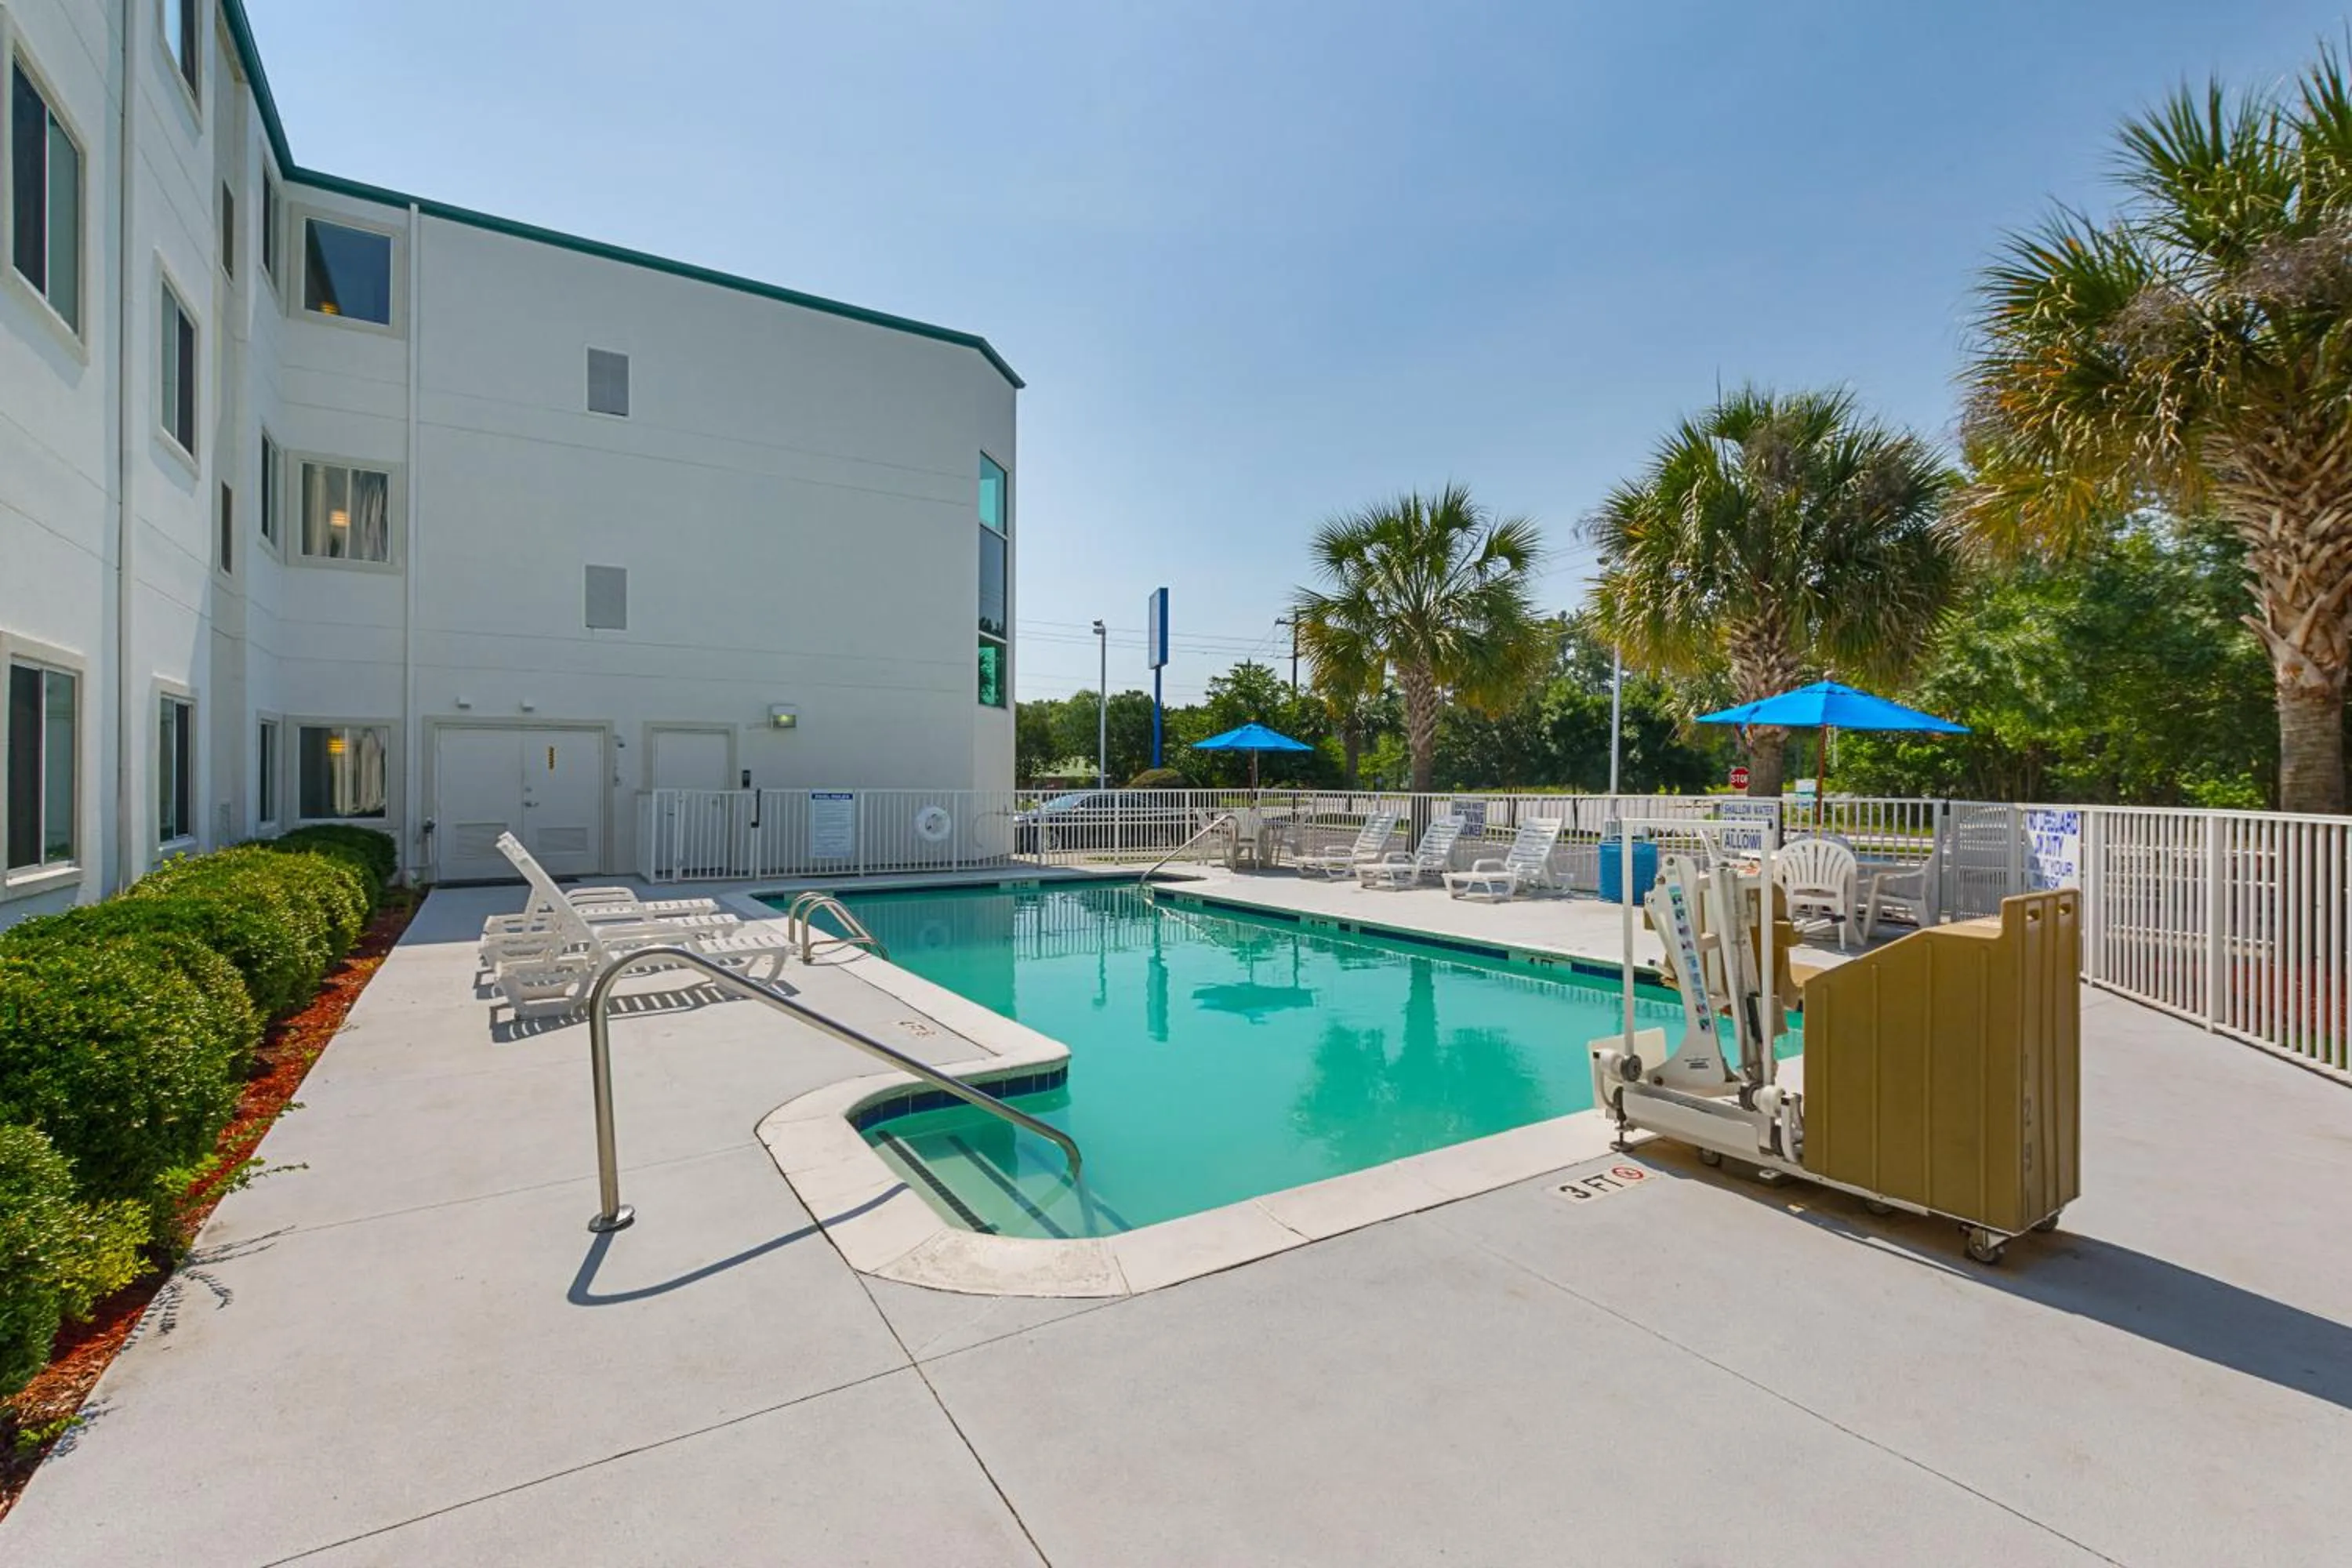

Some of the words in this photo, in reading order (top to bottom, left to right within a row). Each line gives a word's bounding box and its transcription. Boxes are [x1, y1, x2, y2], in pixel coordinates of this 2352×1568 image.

[1754, 805, 1774, 815] WATER
[1560, 1185, 1592, 1198] 3
[1581, 1174, 1624, 1192] FT
